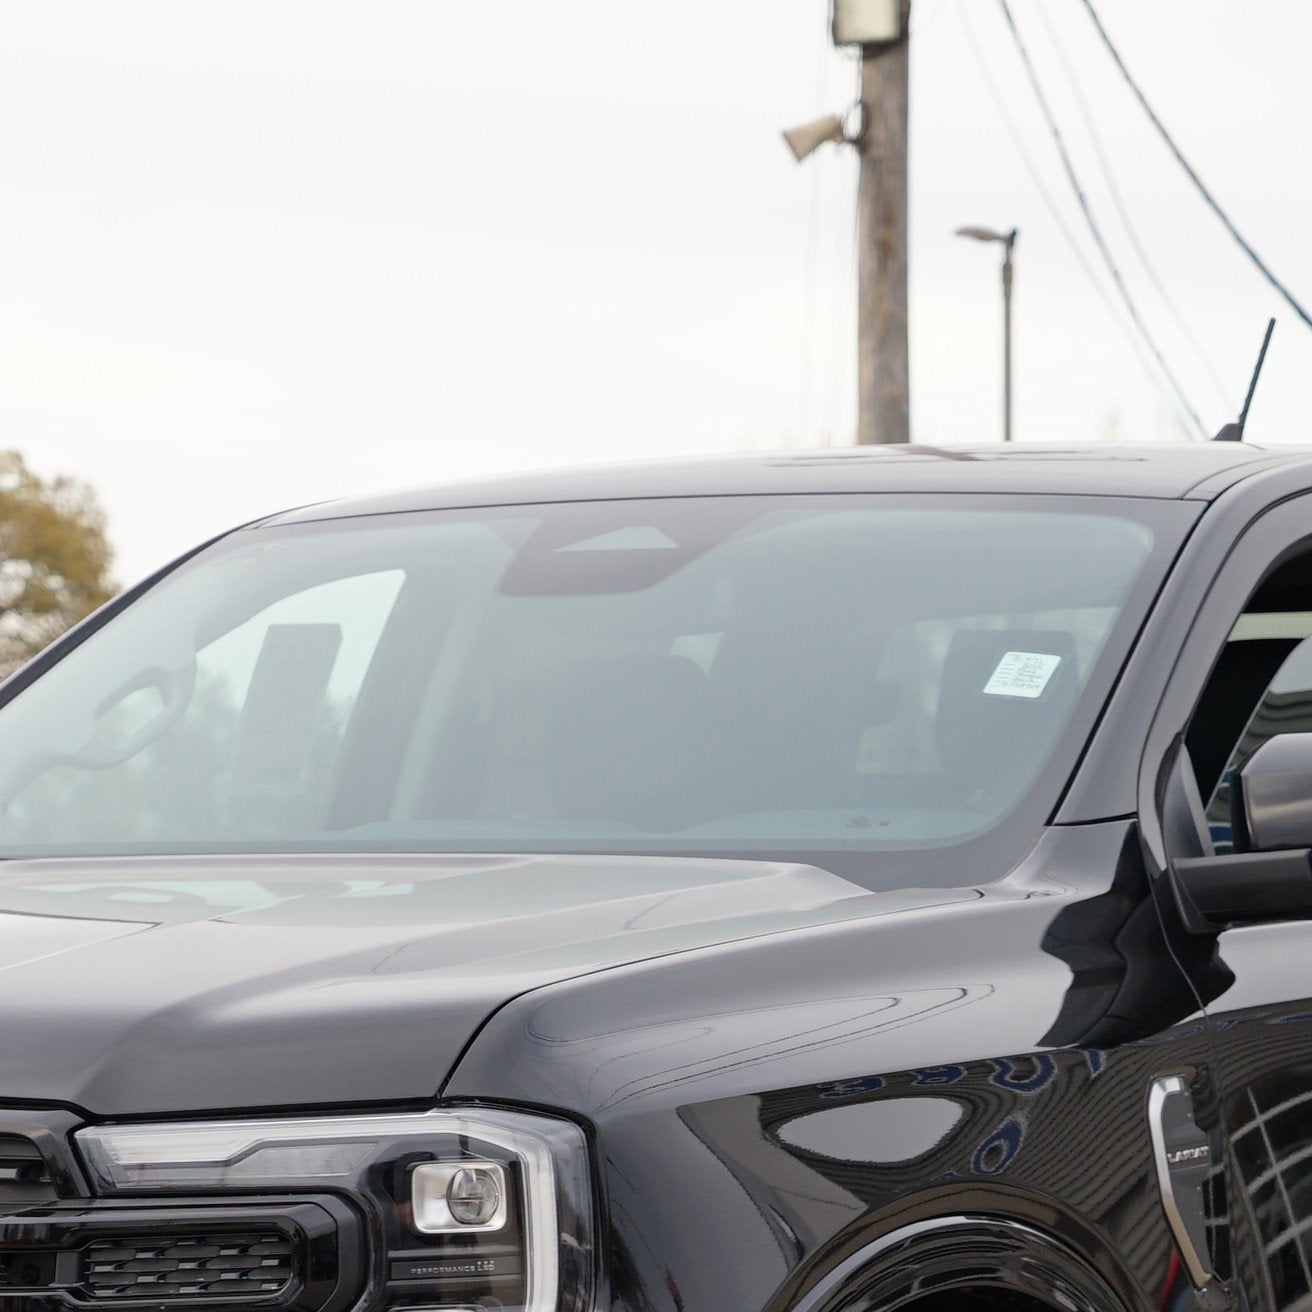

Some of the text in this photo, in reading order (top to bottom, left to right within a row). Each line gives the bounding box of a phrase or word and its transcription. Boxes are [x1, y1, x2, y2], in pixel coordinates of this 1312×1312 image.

[1167, 1145, 1209, 1163] LARIAT
[410, 1262, 495, 1275] PERFORMANCE LED
